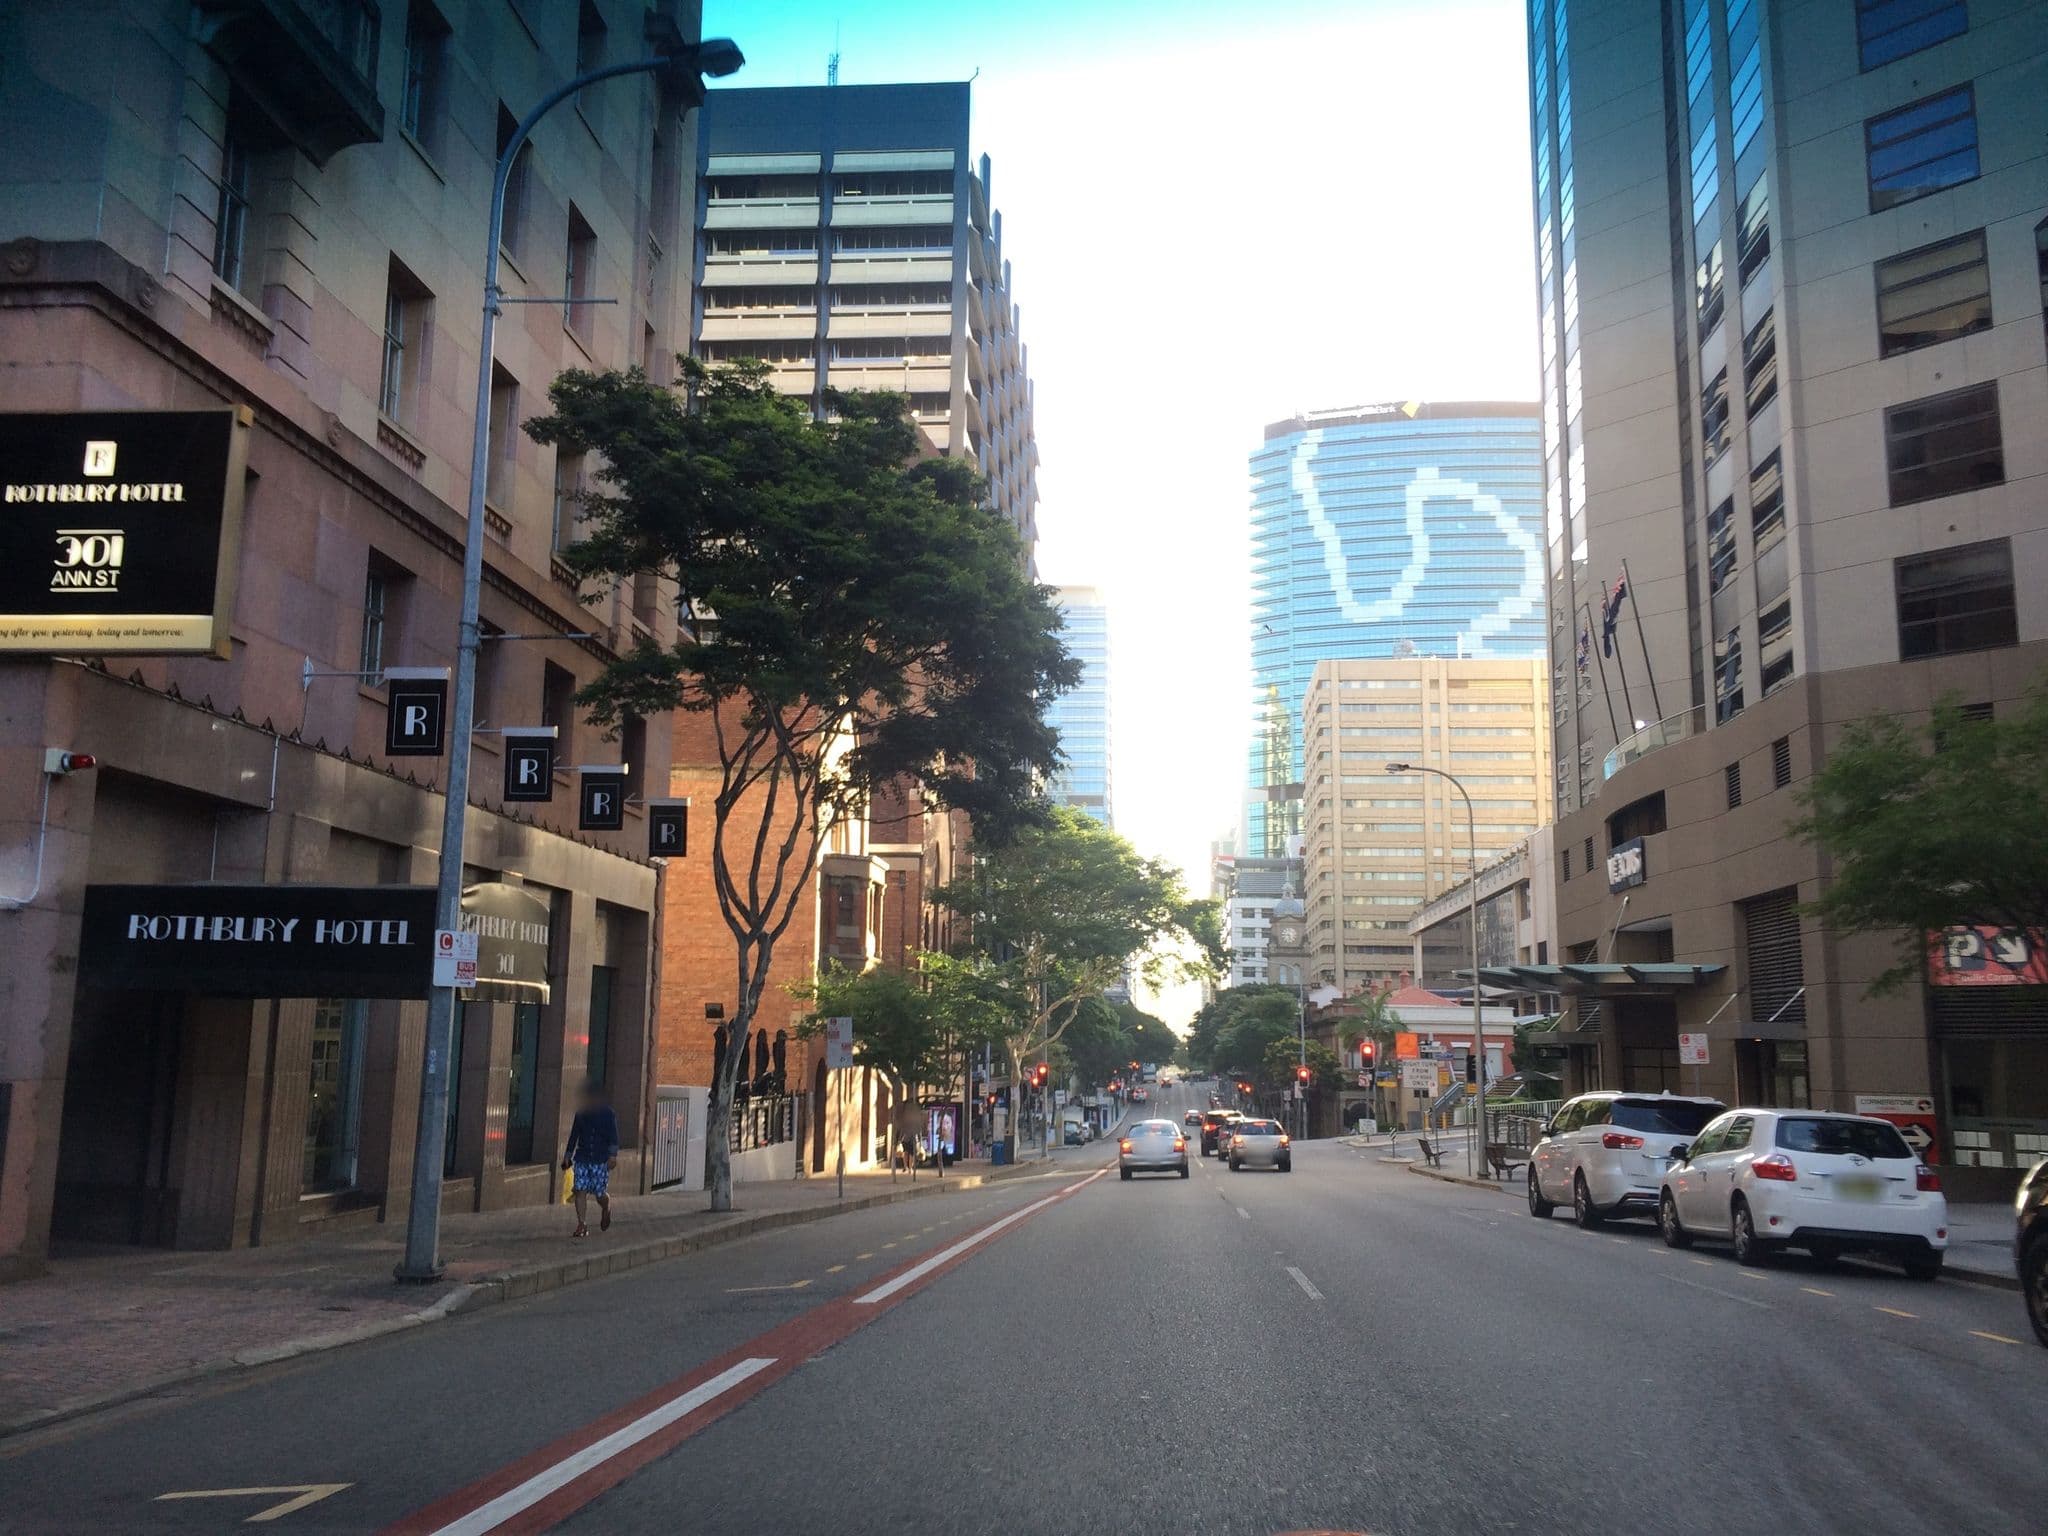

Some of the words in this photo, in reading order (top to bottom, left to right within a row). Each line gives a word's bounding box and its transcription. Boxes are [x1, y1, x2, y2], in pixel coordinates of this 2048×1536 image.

[5, 484, 117, 502] ROTHBURY
[120, 483, 187, 502] HOTEL
[54, 536, 124, 567] 301
[51, 570, 91, 586] ANN
[95, 570, 120, 586] ST
[97, 627, 120, 638] today
[123, 627, 140, 637] and
[404, 705, 428, 736] R
[519, 758, 539, 785] R
[593, 792, 611, 816] R
[660, 823, 676, 844] R
[128, 914, 299, 942] ROTHBURY
[315, 919, 415, 945] HOTEL
[1948, 934, 1978, 968] P
[496, 952, 515, 975] 301
